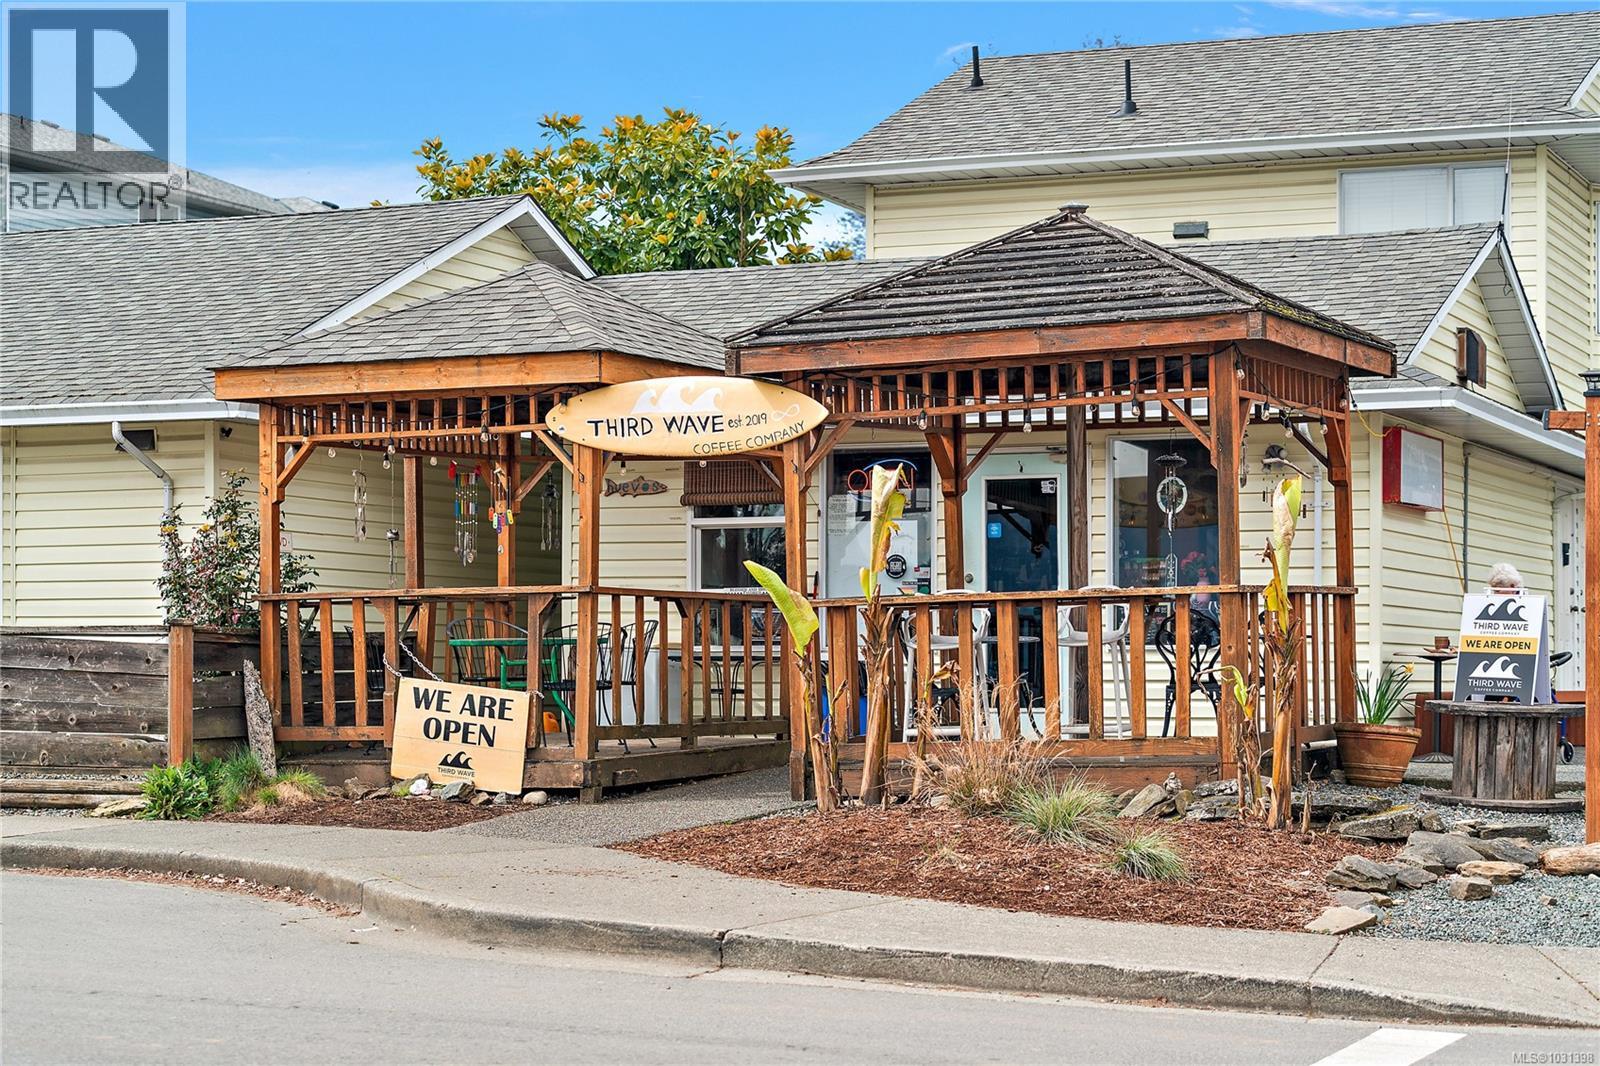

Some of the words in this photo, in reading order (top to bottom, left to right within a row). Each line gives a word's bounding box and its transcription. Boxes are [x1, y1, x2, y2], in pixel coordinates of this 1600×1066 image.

[587, 416, 653, 438] THIRD
[663, 415, 725, 435] WAVE
[745, 412, 767, 427] 2019
[692, 439, 743, 455] COFFEE
[745, 420, 805, 449] COMPANY
[1473, 621, 1500, 631] THIRD
[1502, 623, 1529, 632] WAVE
[1466, 639, 1482, 649] WE
[1483, 640, 1503, 650] ARE
[1504, 641, 1531, 651] OPEN
[1467, 678, 1495, 688] THIRD
[1496, 680, 1523, 689] WAVE
[413, 686, 452, 713] WE
[459, 693, 514, 722] ARE
[423, 717, 496, 748] OPEN
[437, 766, 456, 775] THIRD
[457, 769, 476, 778] WAVE
